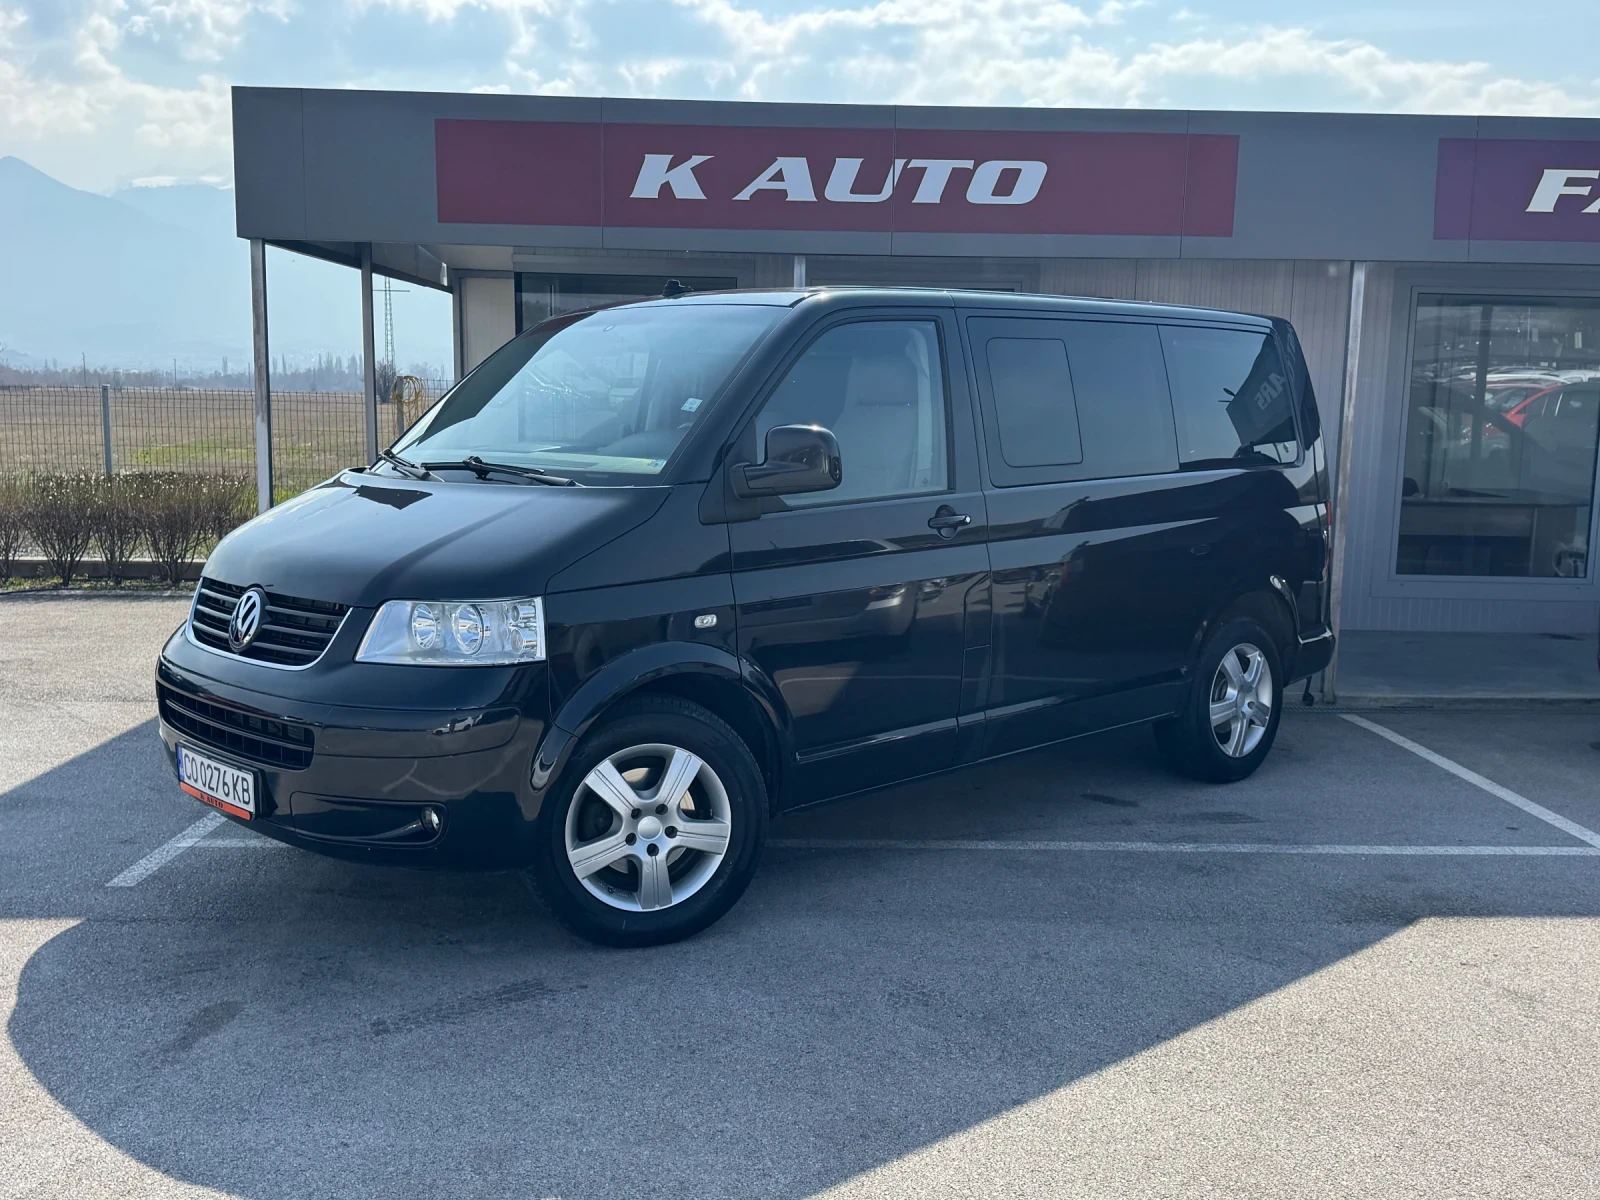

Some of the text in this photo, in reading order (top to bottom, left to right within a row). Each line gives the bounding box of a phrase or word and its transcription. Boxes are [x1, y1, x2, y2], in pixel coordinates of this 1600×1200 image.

[629, 153, 1048, 205] K AUTO
[1525, 168, 1600, 213] F
